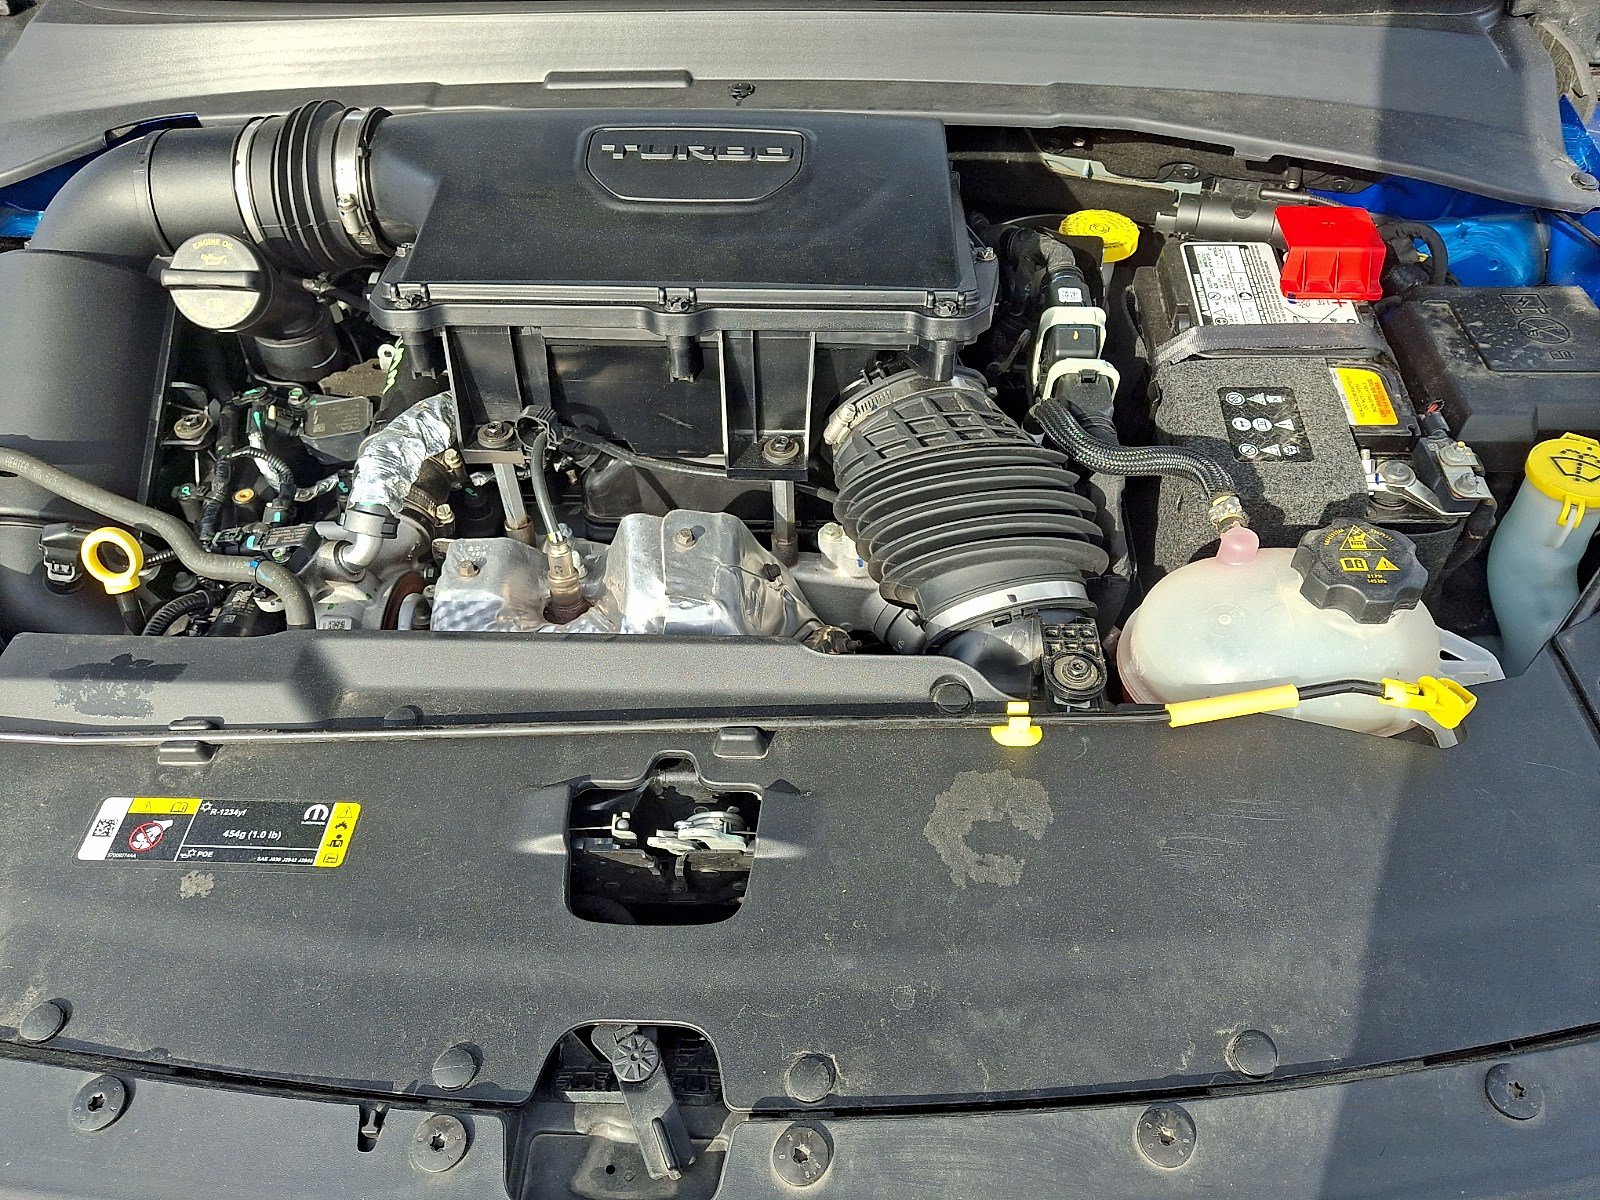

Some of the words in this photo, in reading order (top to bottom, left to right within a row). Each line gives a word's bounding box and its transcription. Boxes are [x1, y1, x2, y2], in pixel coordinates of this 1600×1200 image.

[600, 143, 795, 163] TURBO
[192, 238, 221, 251] ENGINE
[222, 240, 234, 251] OIL
[4, 455, 30, 474] HEATER
[209, 808, 247, 817] R-1234yf
[222, 830, 246, 840] 454g
[247, 831, 267, 840] (1.0
[267, 831, 282, 841] lb)
